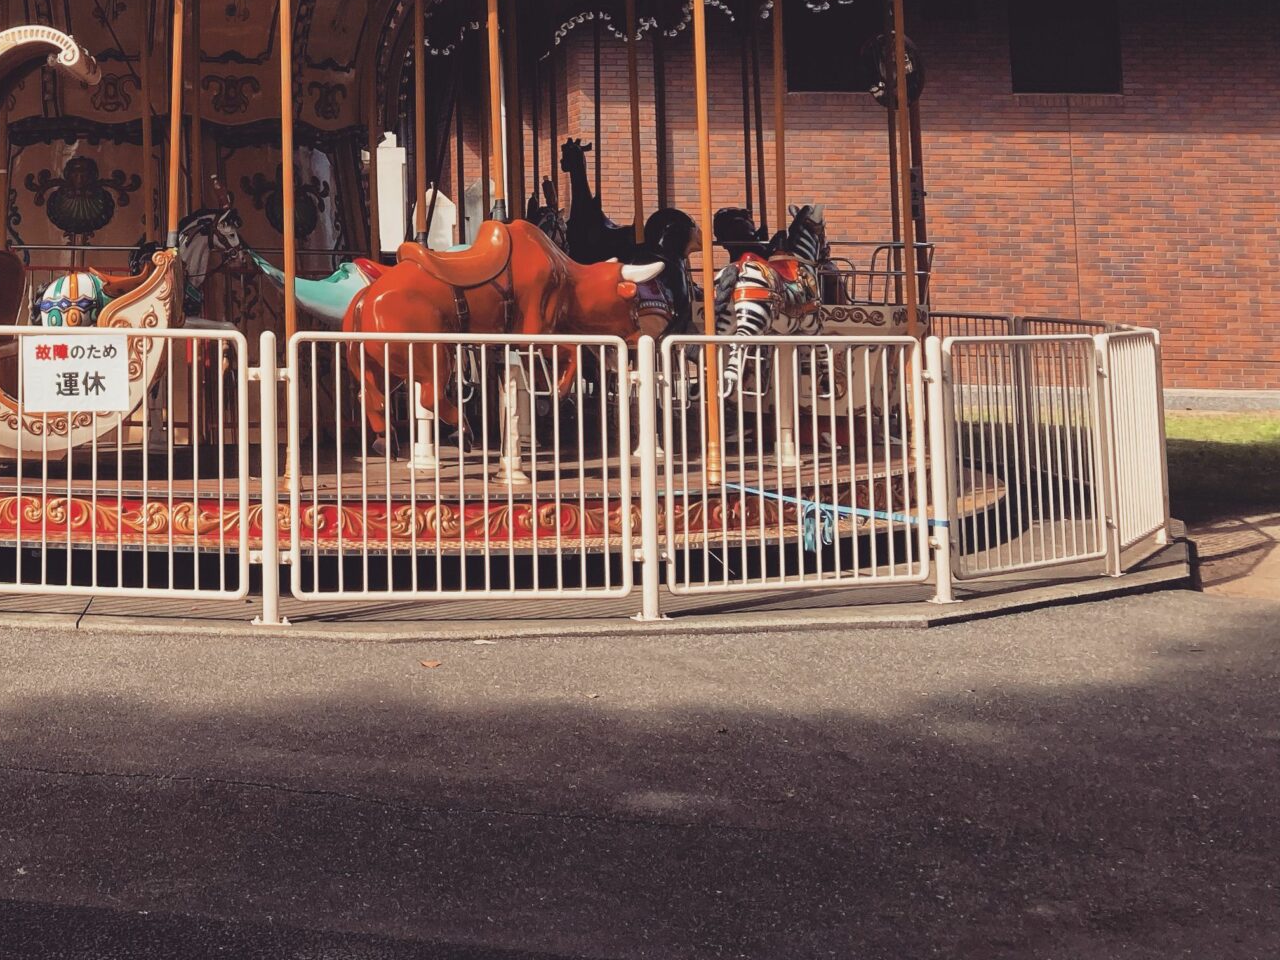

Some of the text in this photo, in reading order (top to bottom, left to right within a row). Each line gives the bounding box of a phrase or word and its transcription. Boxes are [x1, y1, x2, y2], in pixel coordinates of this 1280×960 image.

[35, 344, 117, 361] 故障のため
[55, 371, 106, 396] 運休
